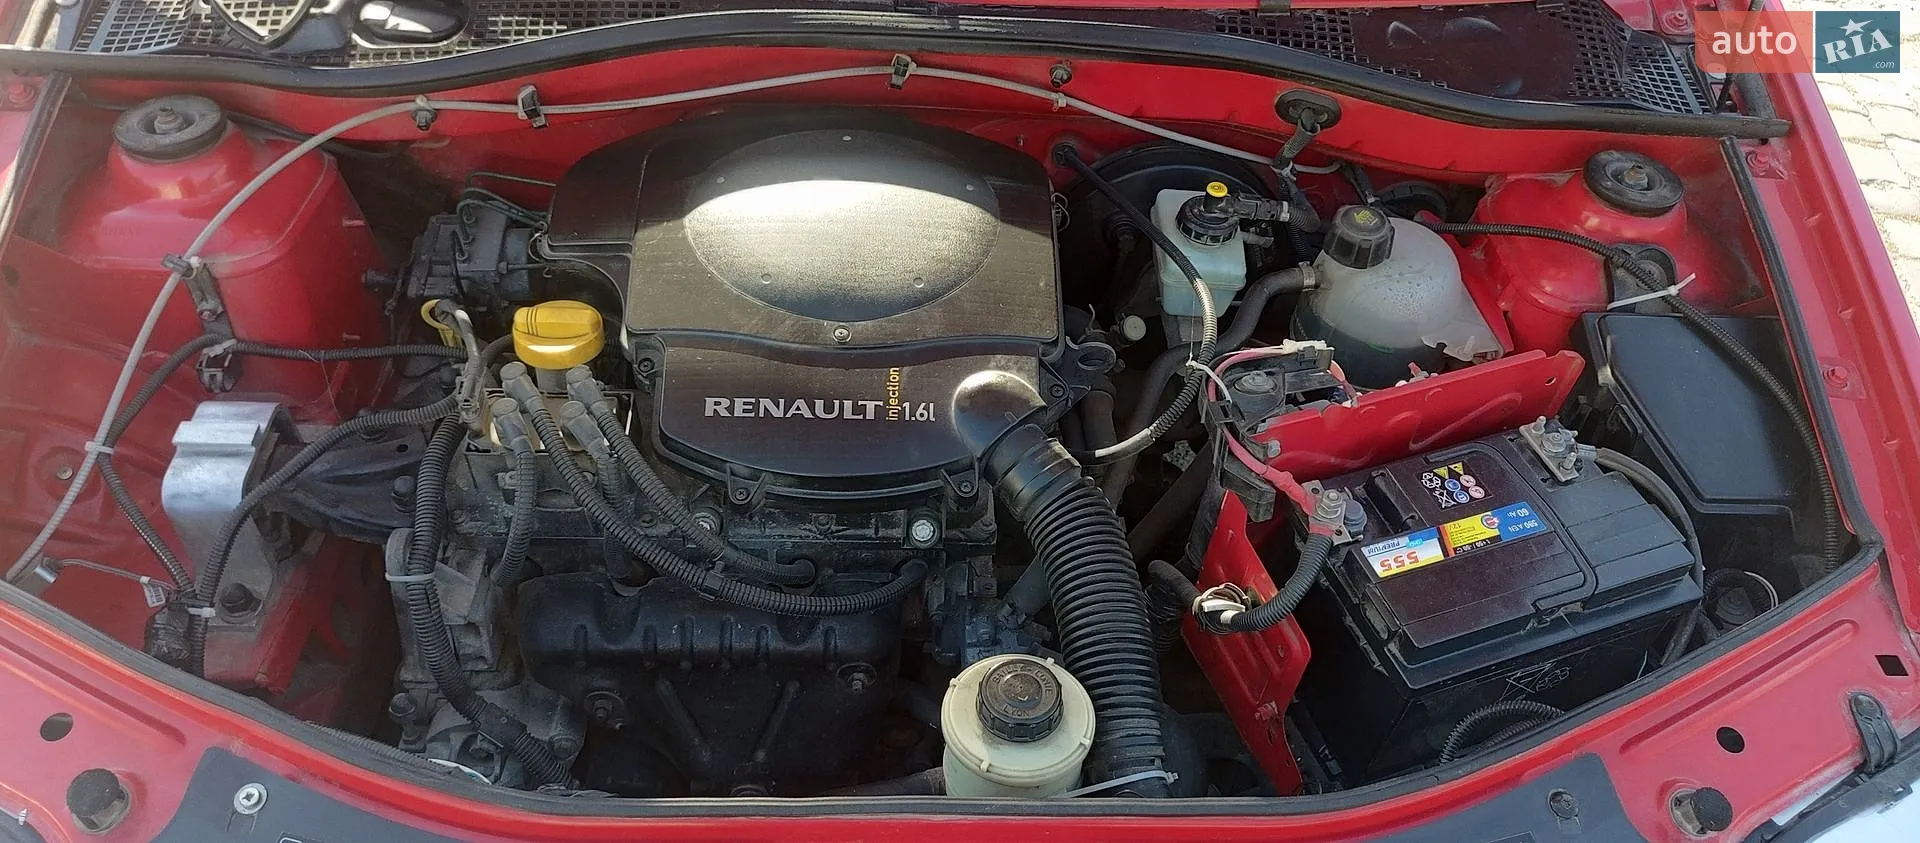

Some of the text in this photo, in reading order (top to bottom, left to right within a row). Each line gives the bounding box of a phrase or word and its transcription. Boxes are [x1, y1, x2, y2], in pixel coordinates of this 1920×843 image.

[886, 367, 900, 421] injection
[704, 397, 884, 420] RENAULT
[1367, 541, 1400, 555] PREMIUM
[1379, 551, 1420, 573] 555
